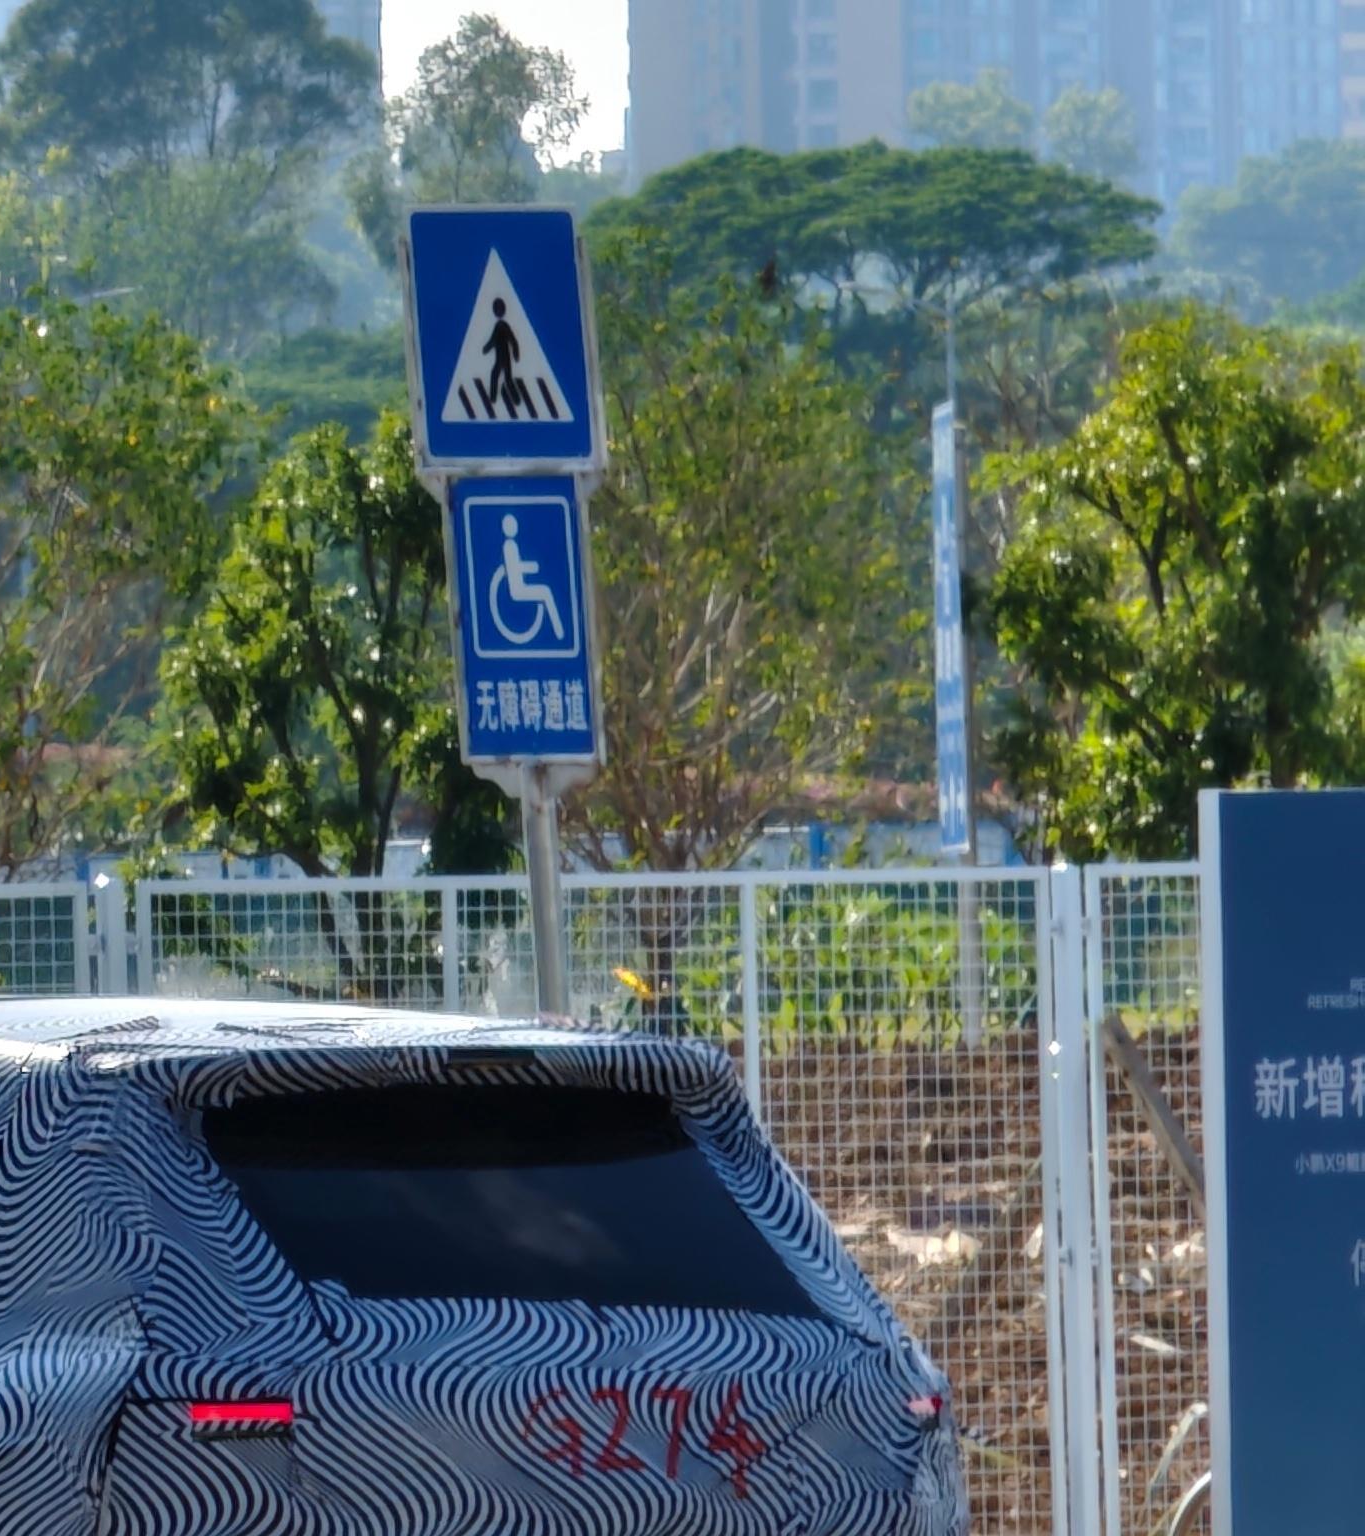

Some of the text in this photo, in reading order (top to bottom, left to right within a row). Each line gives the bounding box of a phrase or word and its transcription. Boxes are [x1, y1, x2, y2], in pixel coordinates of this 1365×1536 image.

[477, 679, 588, 733] 无障碍通道
